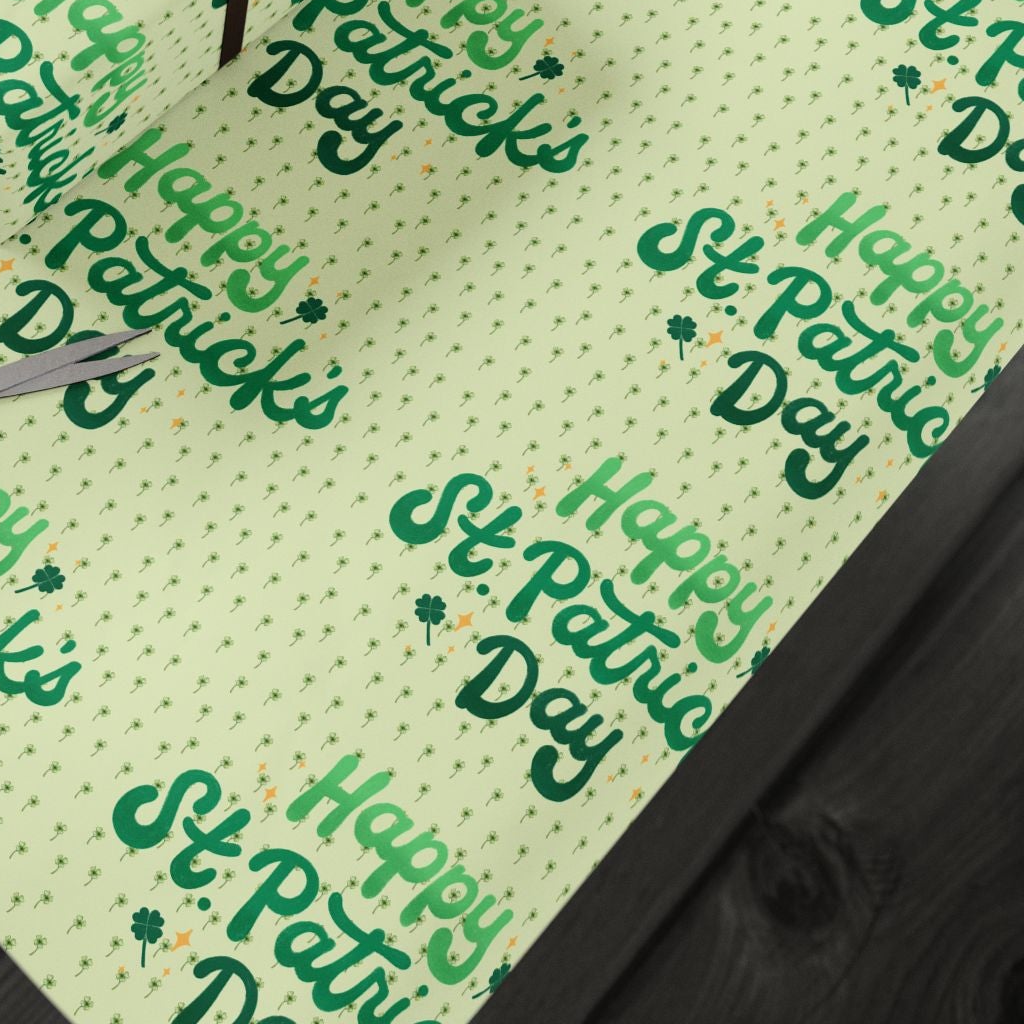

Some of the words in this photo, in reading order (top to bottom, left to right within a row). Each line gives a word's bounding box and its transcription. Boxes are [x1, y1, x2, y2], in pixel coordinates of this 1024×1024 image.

[247, 40, 403, 175] Day
[97, 127, 310, 314] Happy
[796, 191, 1004, 377] Happy
[44, 199, 349, 430] Patrick's
[637, 207, 764, 316] St.
[753, 266, 950, 467] Patric
[710, 350, 870, 500] Day
[389, 473, 523, 596] St.
[506, 540, 712, 765] Patric
[556, 456, 774, 664] Happy
[455, 634, 623, 802] Day
[112, 769, 251, 911] St.
[285, 754, 514, 985] Happy
